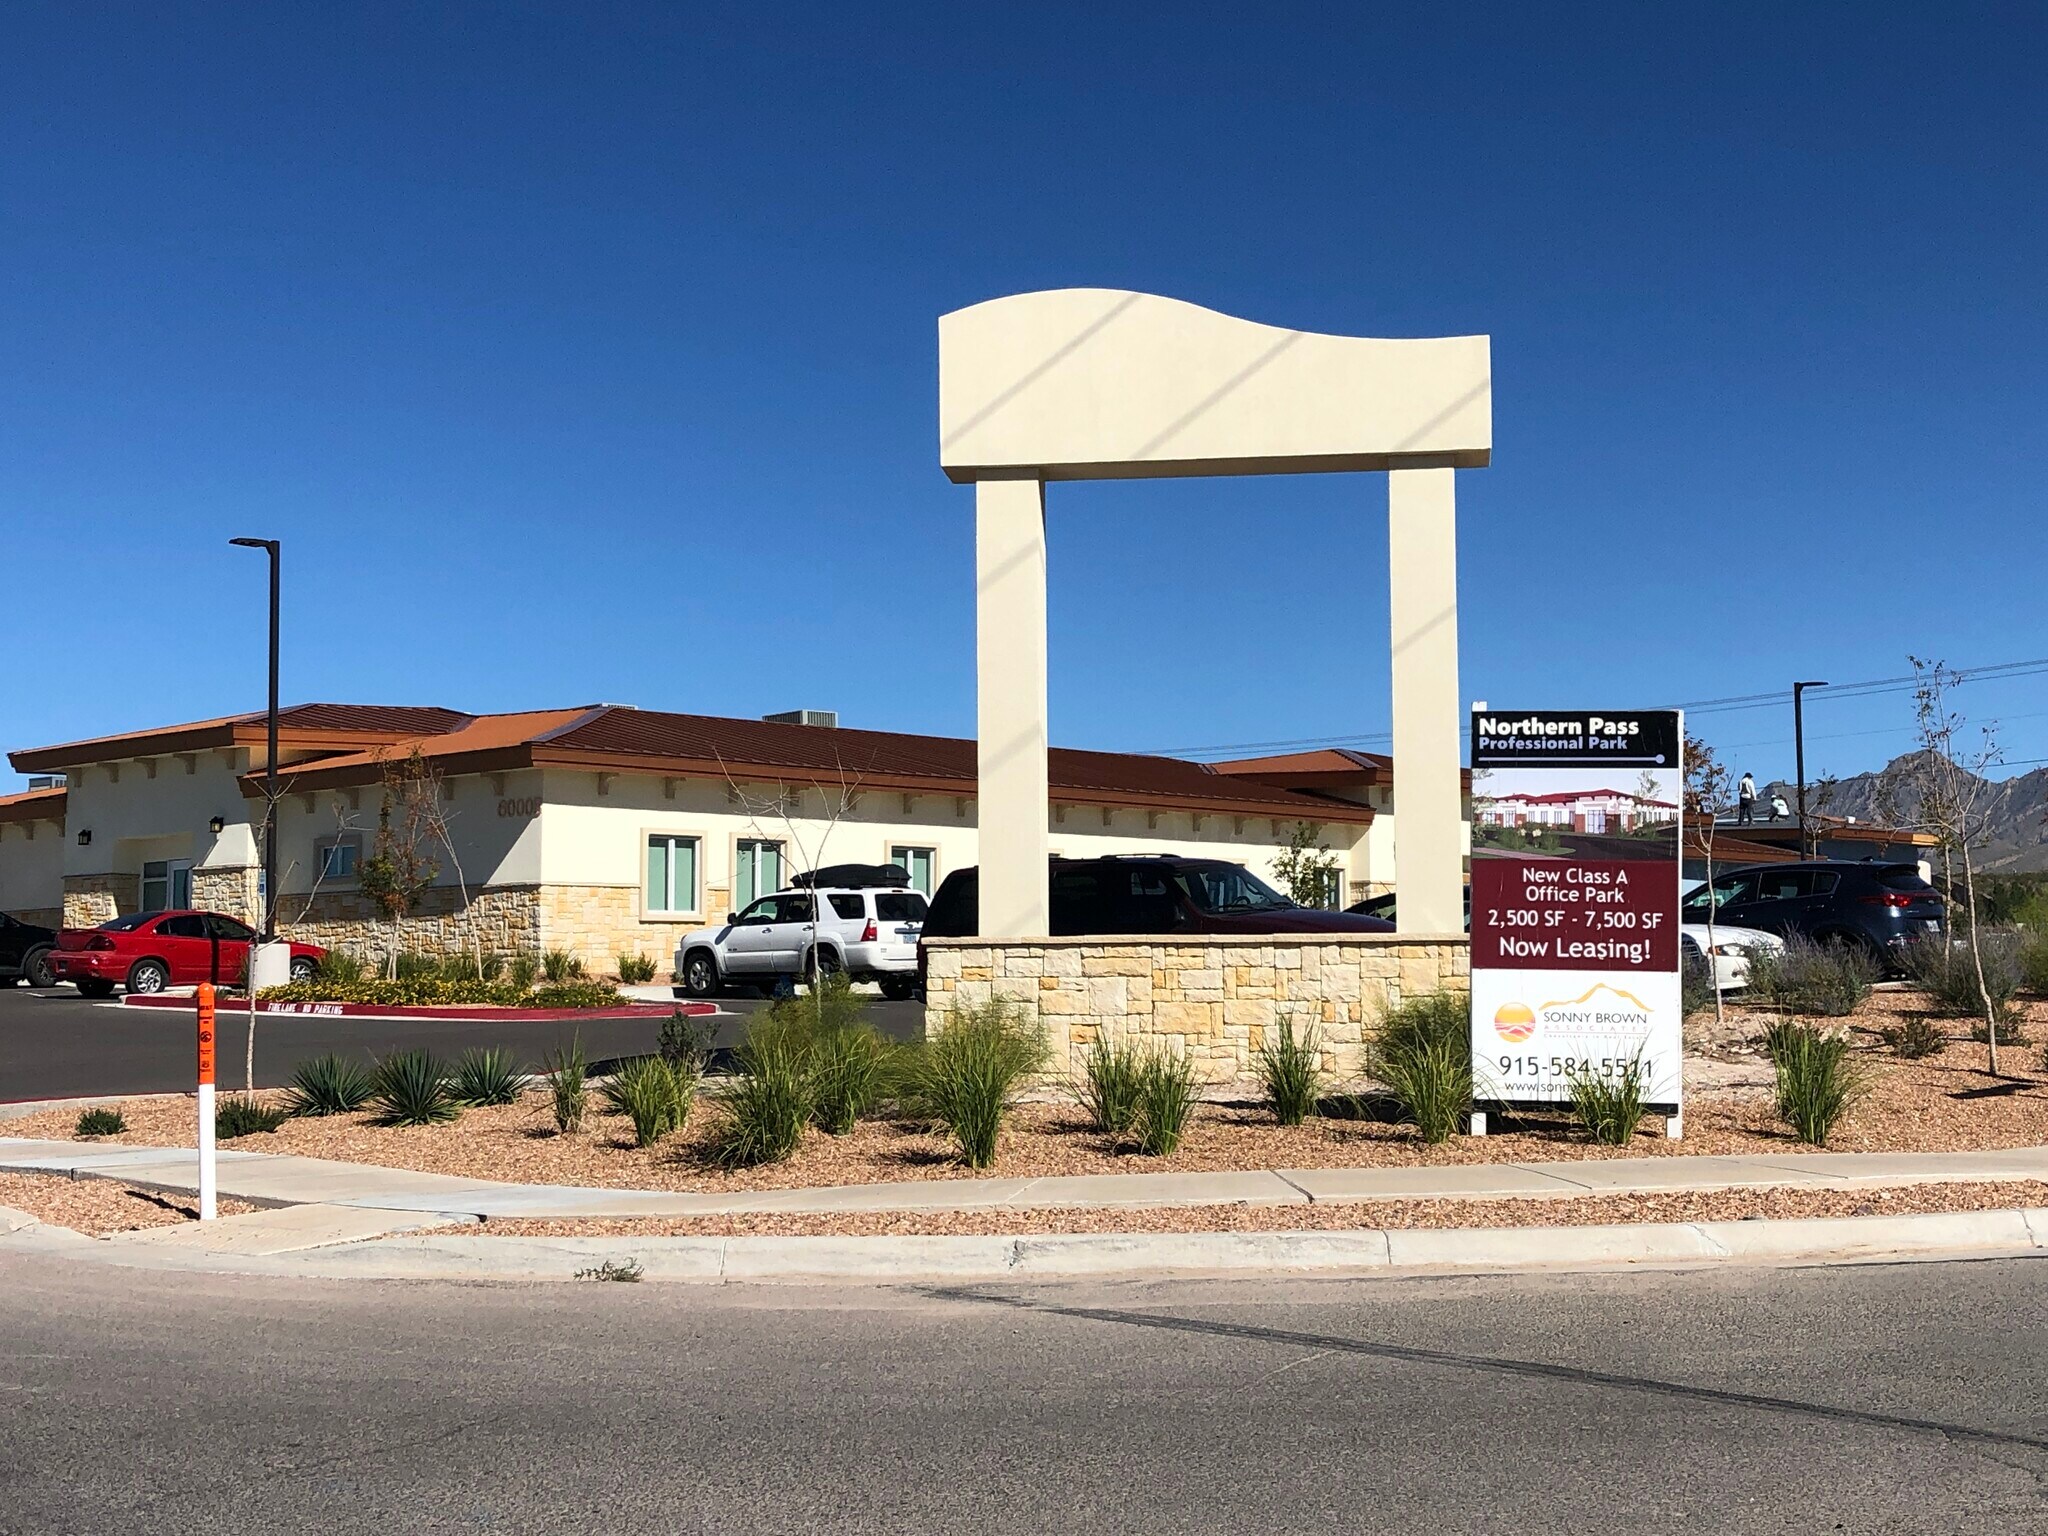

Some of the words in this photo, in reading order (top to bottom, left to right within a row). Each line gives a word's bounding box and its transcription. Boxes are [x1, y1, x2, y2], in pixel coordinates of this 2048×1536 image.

[1479, 717, 1582, 735] Northern
[1589, 718, 1639, 735] Pass
[1479, 736, 1583, 750] Professional
[1588, 736, 1628, 750] Park
[1522, 868, 1560, 883] New
[1566, 868, 1610, 884] Class
[1616, 869, 1628, 884] A
[1525, 886, 1580, 902] Office
[1585, 887, 1625, 903] Park
[1488, 910, 1538, 928] 2,500
[1544, 911, 1566, 927] SF
[1585, 911, 1636, 930] 7,500
[1642, 912, 1663, 929] SF
[1499, 937, 1548, 957] Now
[1556, 938, 1651, 963] Leasing!
[314, 1004, 344, 1015] PARKING
[1543, 1012, 1591, 1022] SONNY
[1596, 1013, 1647, 1023] BROWN
[1500, 1056, 1652, 1078] 915-584-5511
